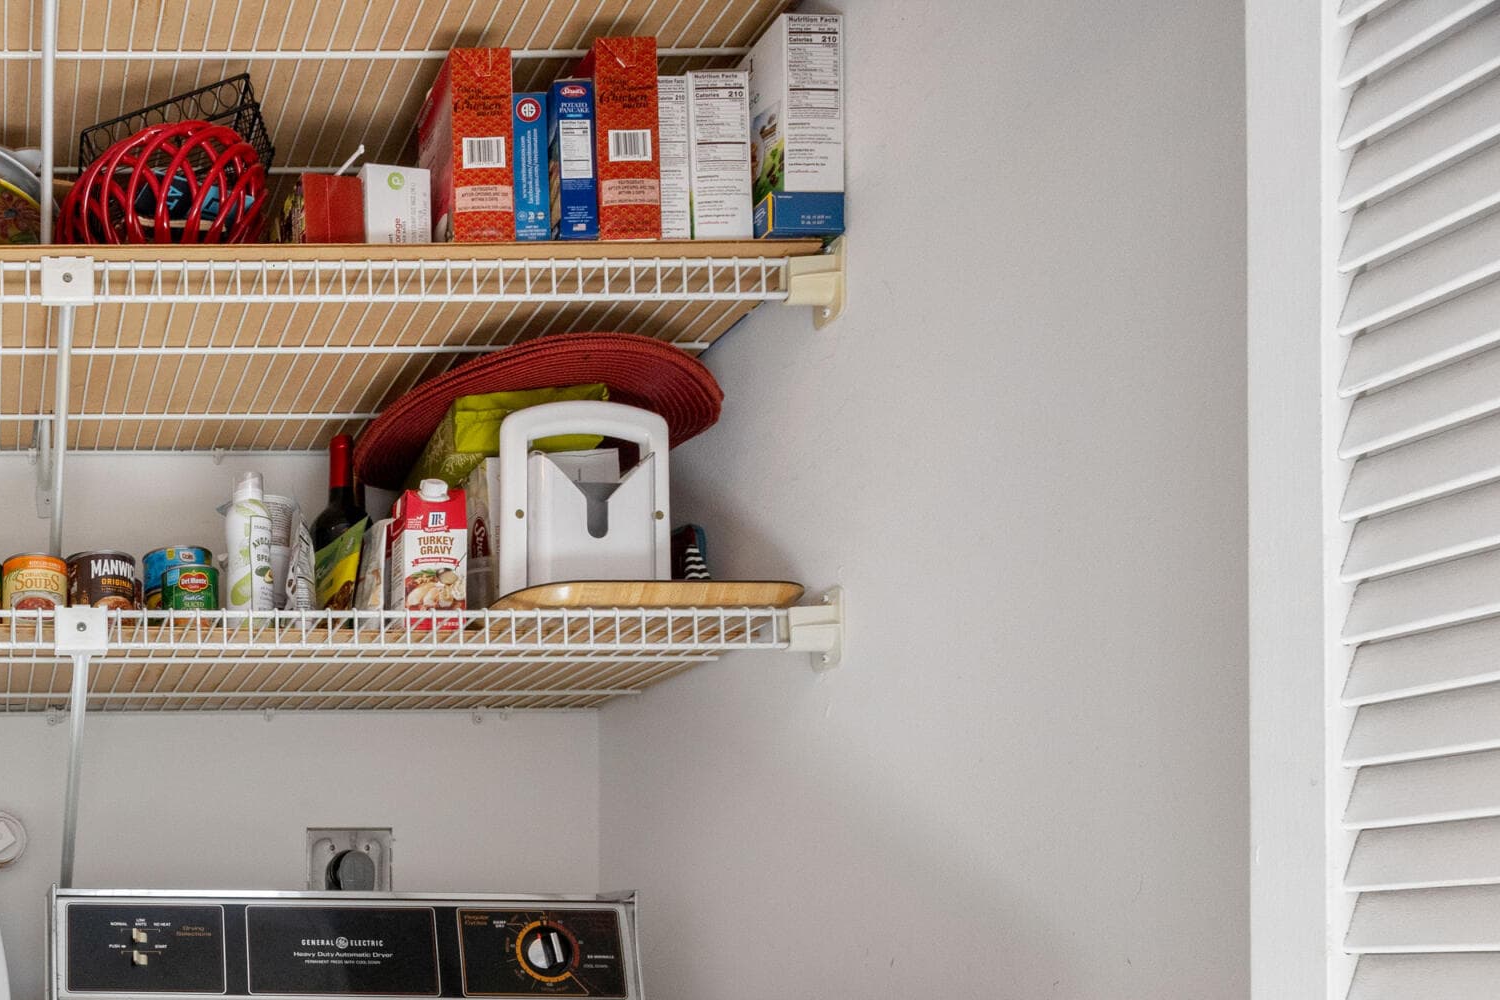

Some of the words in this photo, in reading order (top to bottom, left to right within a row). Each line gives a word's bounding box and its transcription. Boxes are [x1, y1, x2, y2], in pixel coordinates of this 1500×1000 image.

[417, 536, 455, 546] TURKEY
[420, 545, 453, 556] GRAVY
[14, 574, 60, 592] SOUPS
[190, 577, 207, 585] Monte
[350, 939, 384, 947] ELECTRIC
